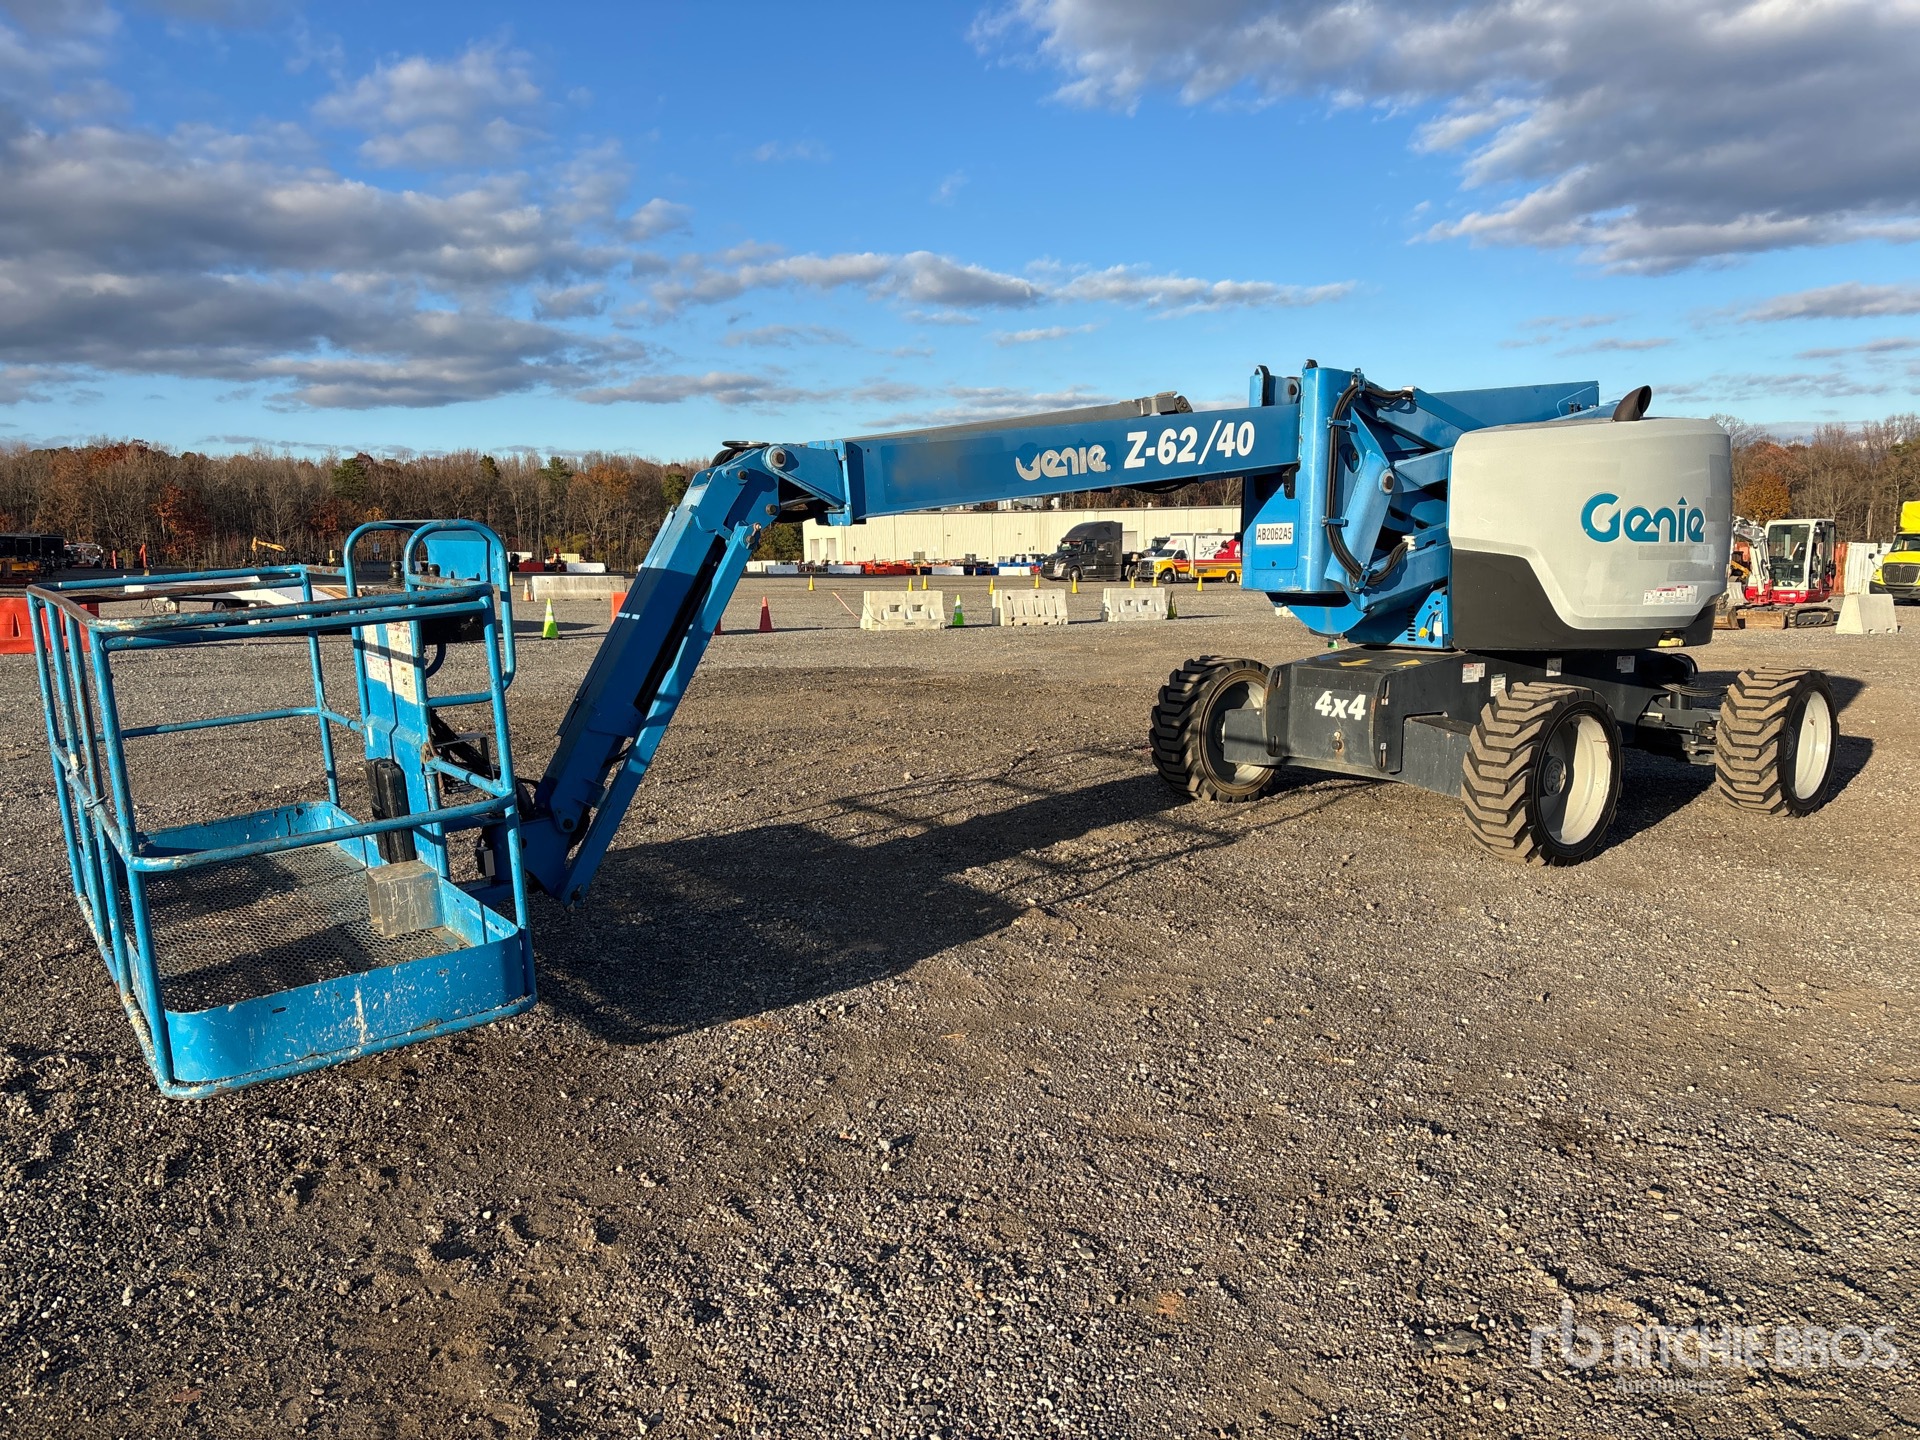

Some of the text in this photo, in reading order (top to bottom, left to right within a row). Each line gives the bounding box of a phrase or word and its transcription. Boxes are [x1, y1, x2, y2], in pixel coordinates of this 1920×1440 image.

[1124, 420, 1255, 469] Z-62/40
[1257, 527, 1292, 540] AB2062A5
[1580, 492, 1705, 542] Genie
[1315, 690, 1366, 721] 4x4
